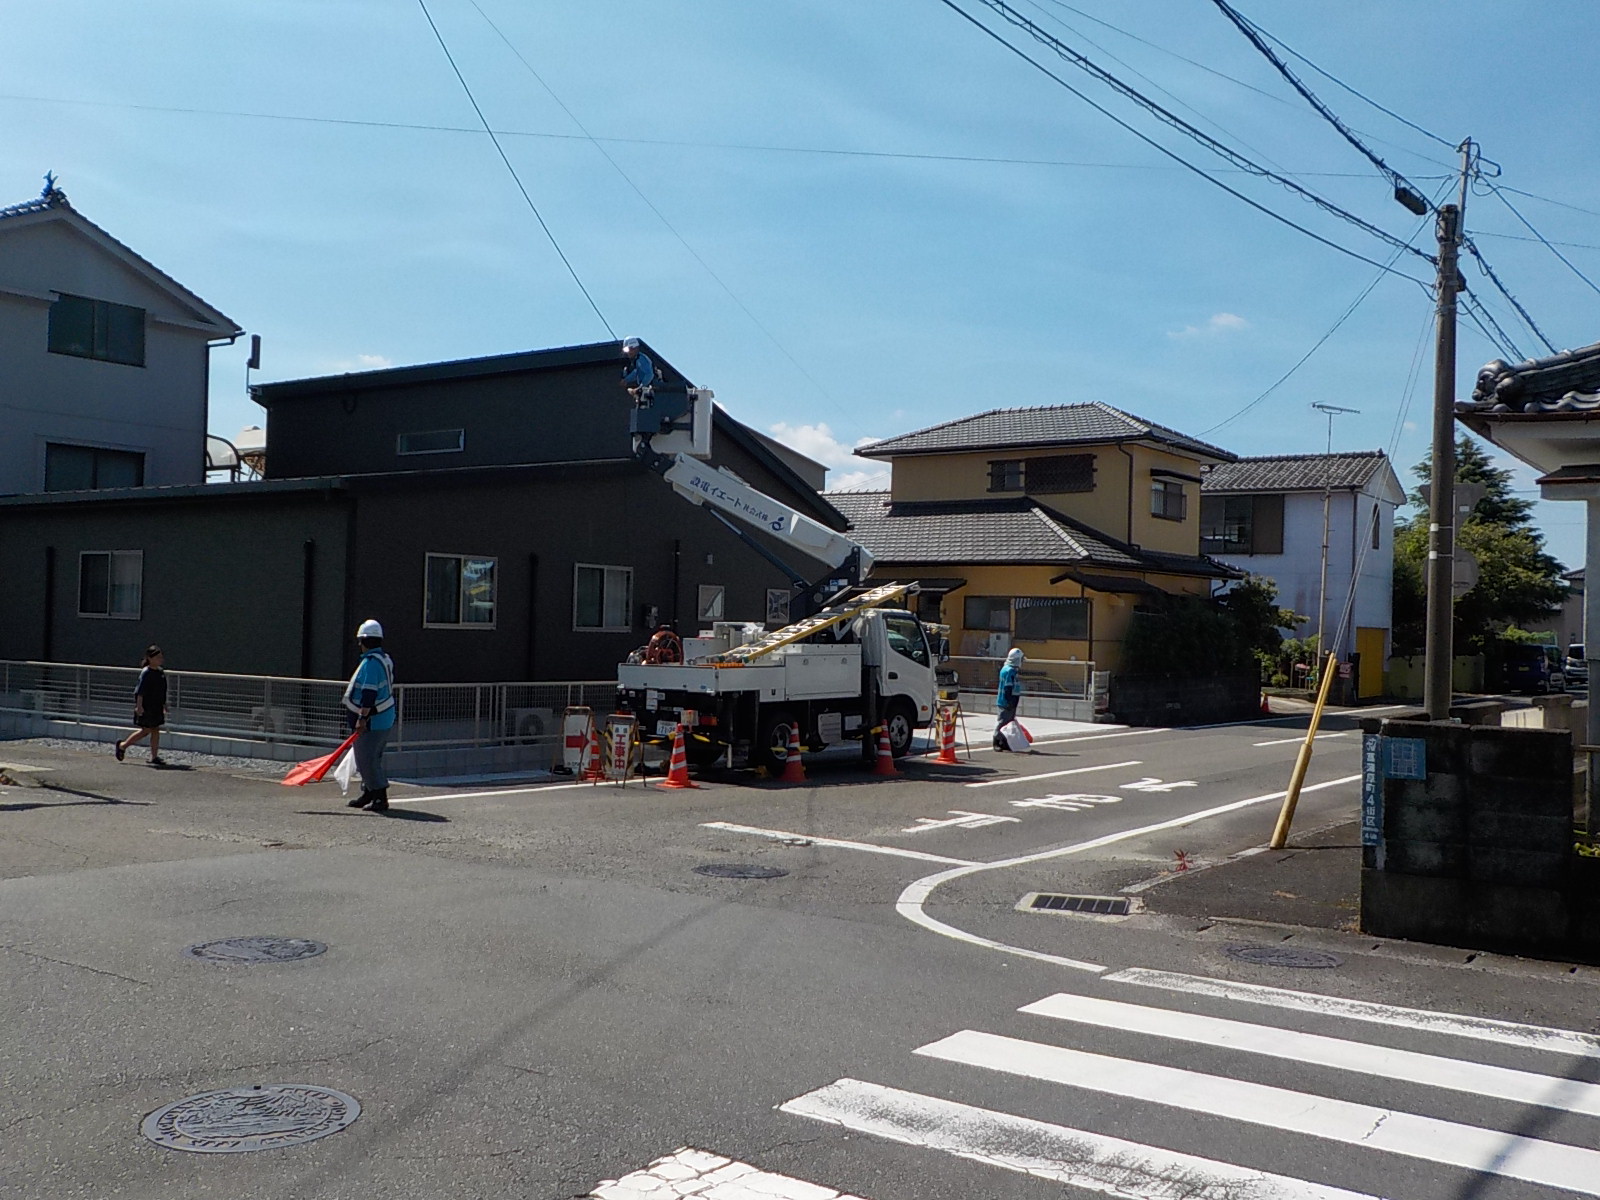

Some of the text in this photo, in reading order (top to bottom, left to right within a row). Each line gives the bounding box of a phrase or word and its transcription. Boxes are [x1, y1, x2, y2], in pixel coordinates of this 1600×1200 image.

[615, 734, 626, 769] 工事中
[901, 777, 1199, 833] 止まれ
